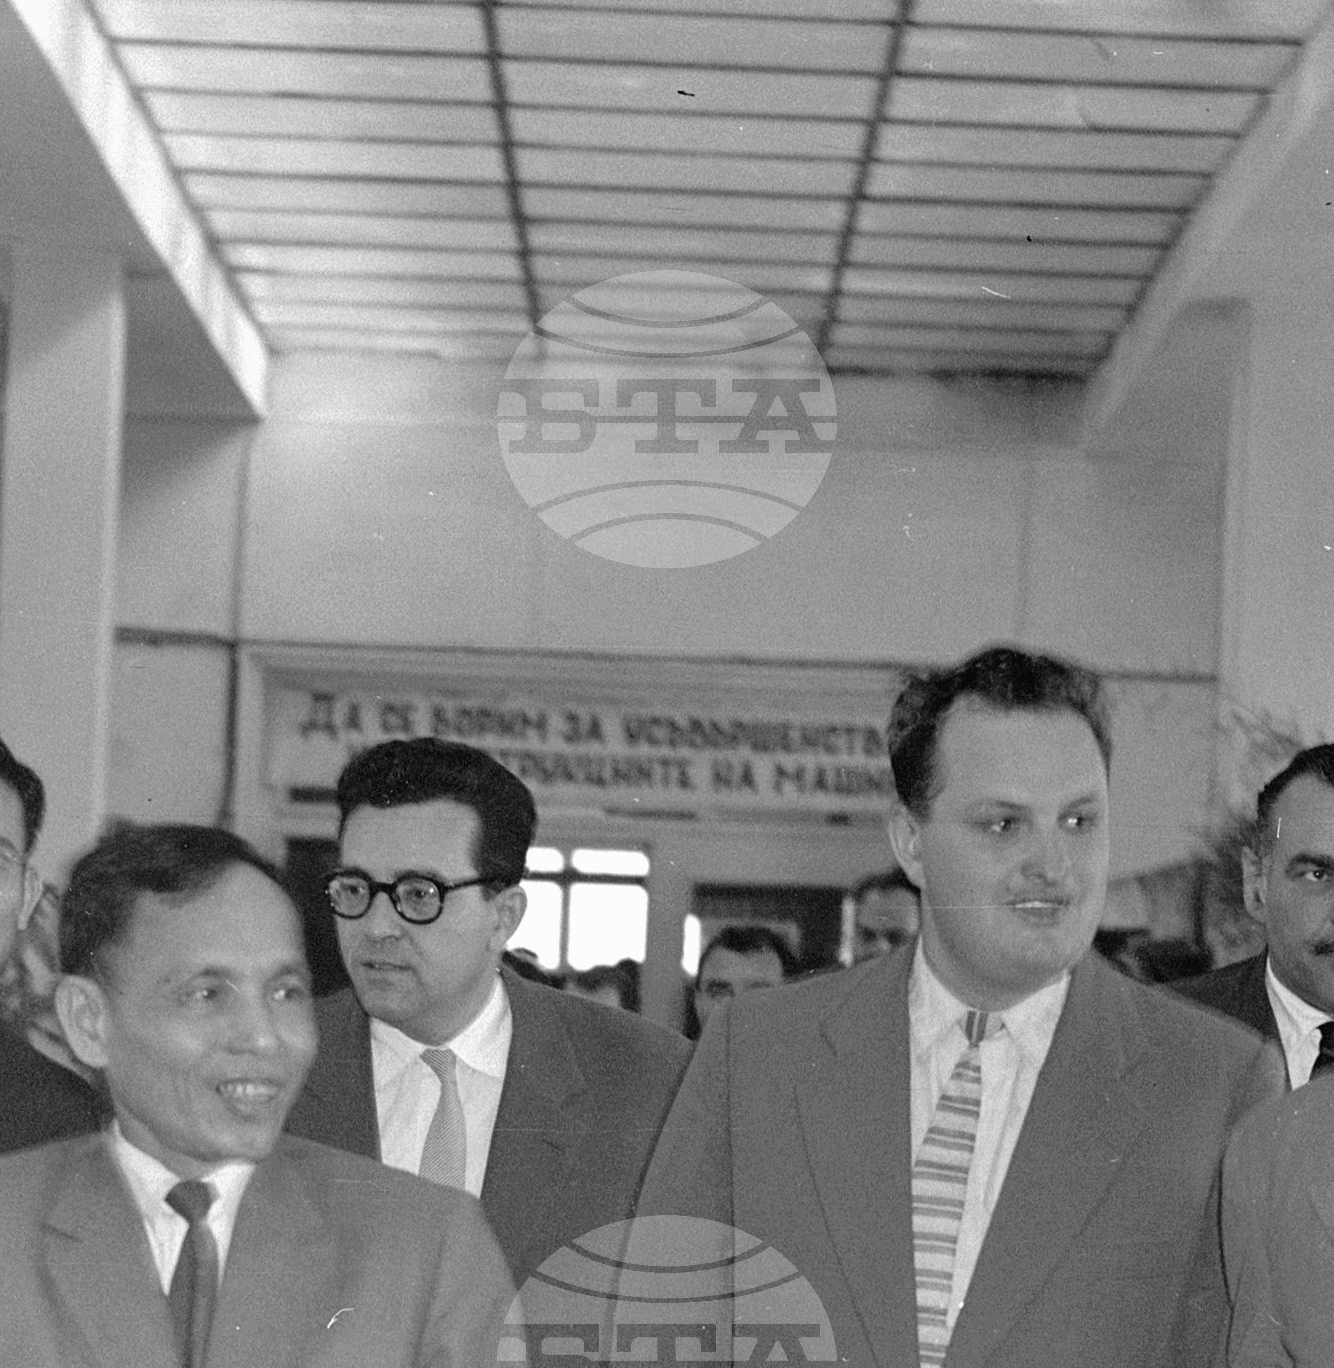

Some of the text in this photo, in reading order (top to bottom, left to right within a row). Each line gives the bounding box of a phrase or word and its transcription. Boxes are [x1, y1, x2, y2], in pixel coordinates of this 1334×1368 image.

[298, 692, 363, 739] ДА
[432, 704, 548, 742] БОРИМ
[562, 709, 605, 745] ЗА
[622, 714, 885, 758] УСЪВЪРШЕНСТВ
[712, 758, 759, 794] НА
